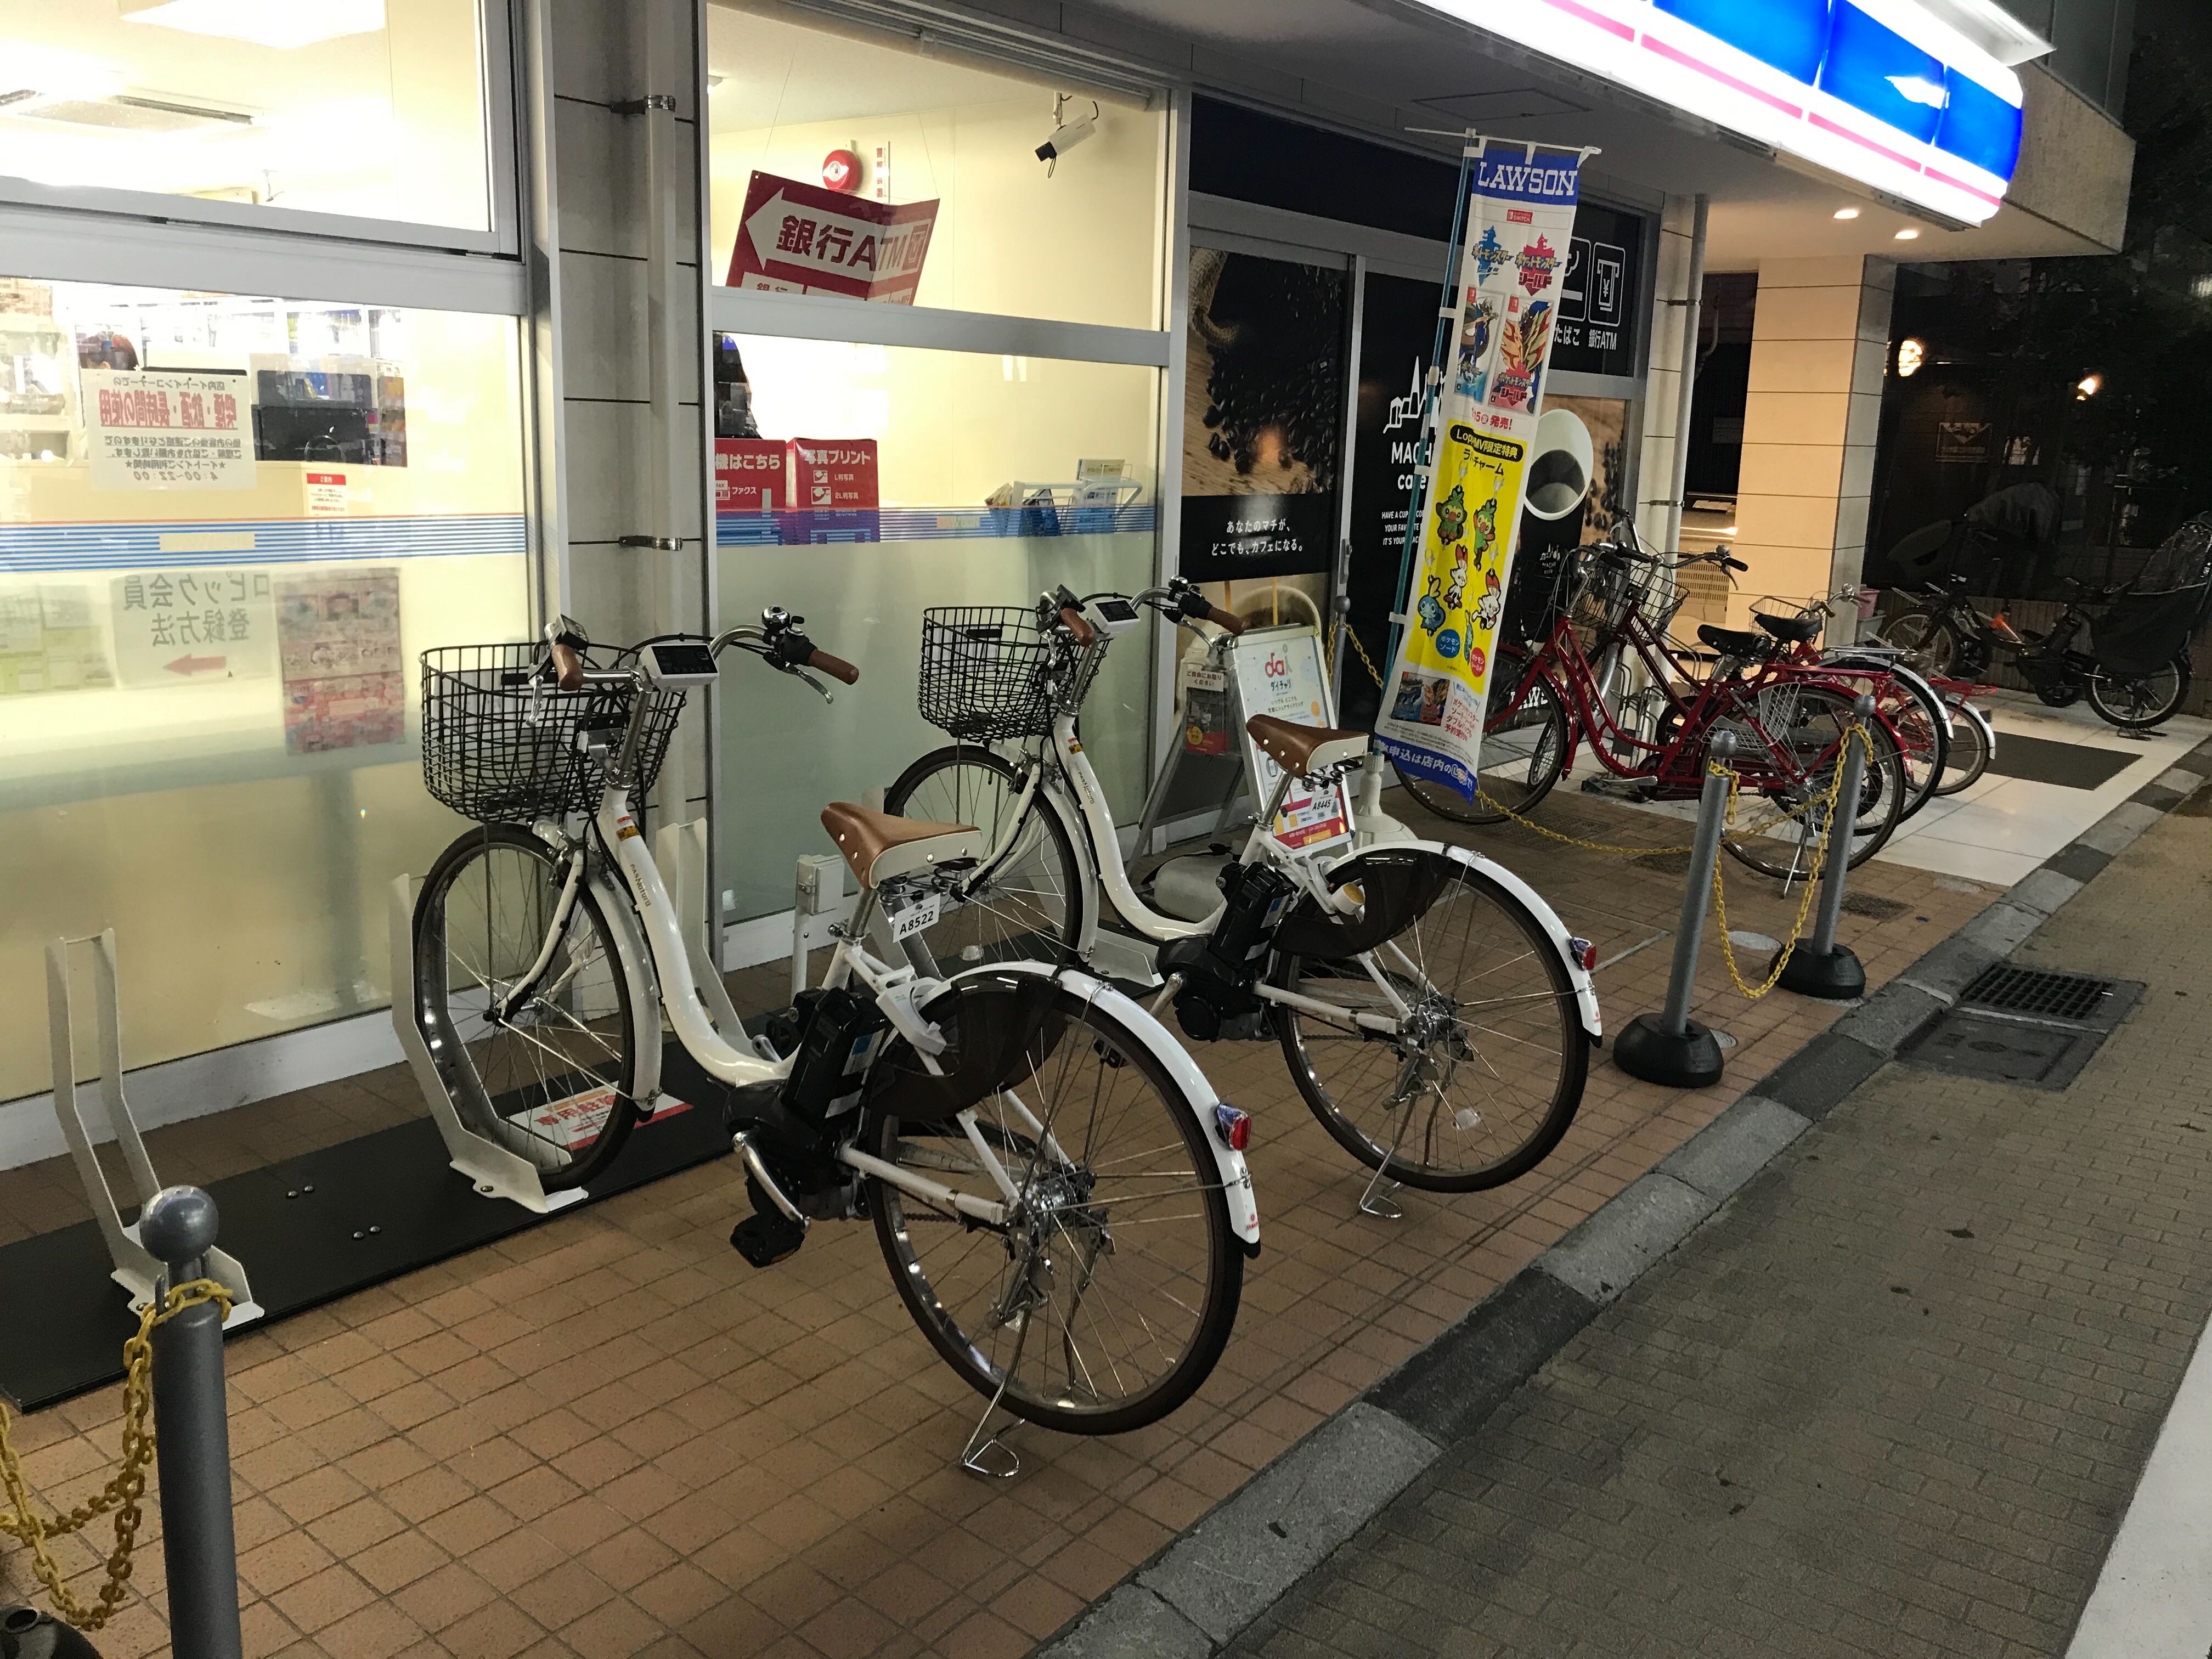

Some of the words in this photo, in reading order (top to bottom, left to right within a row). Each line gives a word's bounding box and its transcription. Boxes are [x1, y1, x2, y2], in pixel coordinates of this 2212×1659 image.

[1479, 161, 1578, 196] LAWSON
[1515, 252, 1562, 272] ポケットモンスター
[1519, 272, 1552, 289] シールド
[1554, 324, 1580, 346] たばこ
[1588, 329, 1617, 350] 銀行ATM
[715, 453, 781, 470] 機はこちら
[804, 449, 871, 465] 写真プリント
[731, 486, 757, 495] ファクス
[834, 491, 859, 500] 2L判写真
[1382, 511, 1394, 520] HAVE
[1399, 511, 1409, 519] CUP
[1226, 518, 1290, 534] あなたのマチが、
[1385, 524, 1398, 532] YOUR
[1211, 539, 1303, 556] どこでも、カフェになる。
[1383, 538, 1392, 546] IT'S
[1440, 636, 1459, 646] ポケモン
[1440, 644, 1458, 653] ソード
[1271, 679, 1291, 691] ダイチャリ
[1312, 800, 1331, 811] A8445
[635, 878, 651, 907] Natura
[899, 911, 934, 935] A8522
